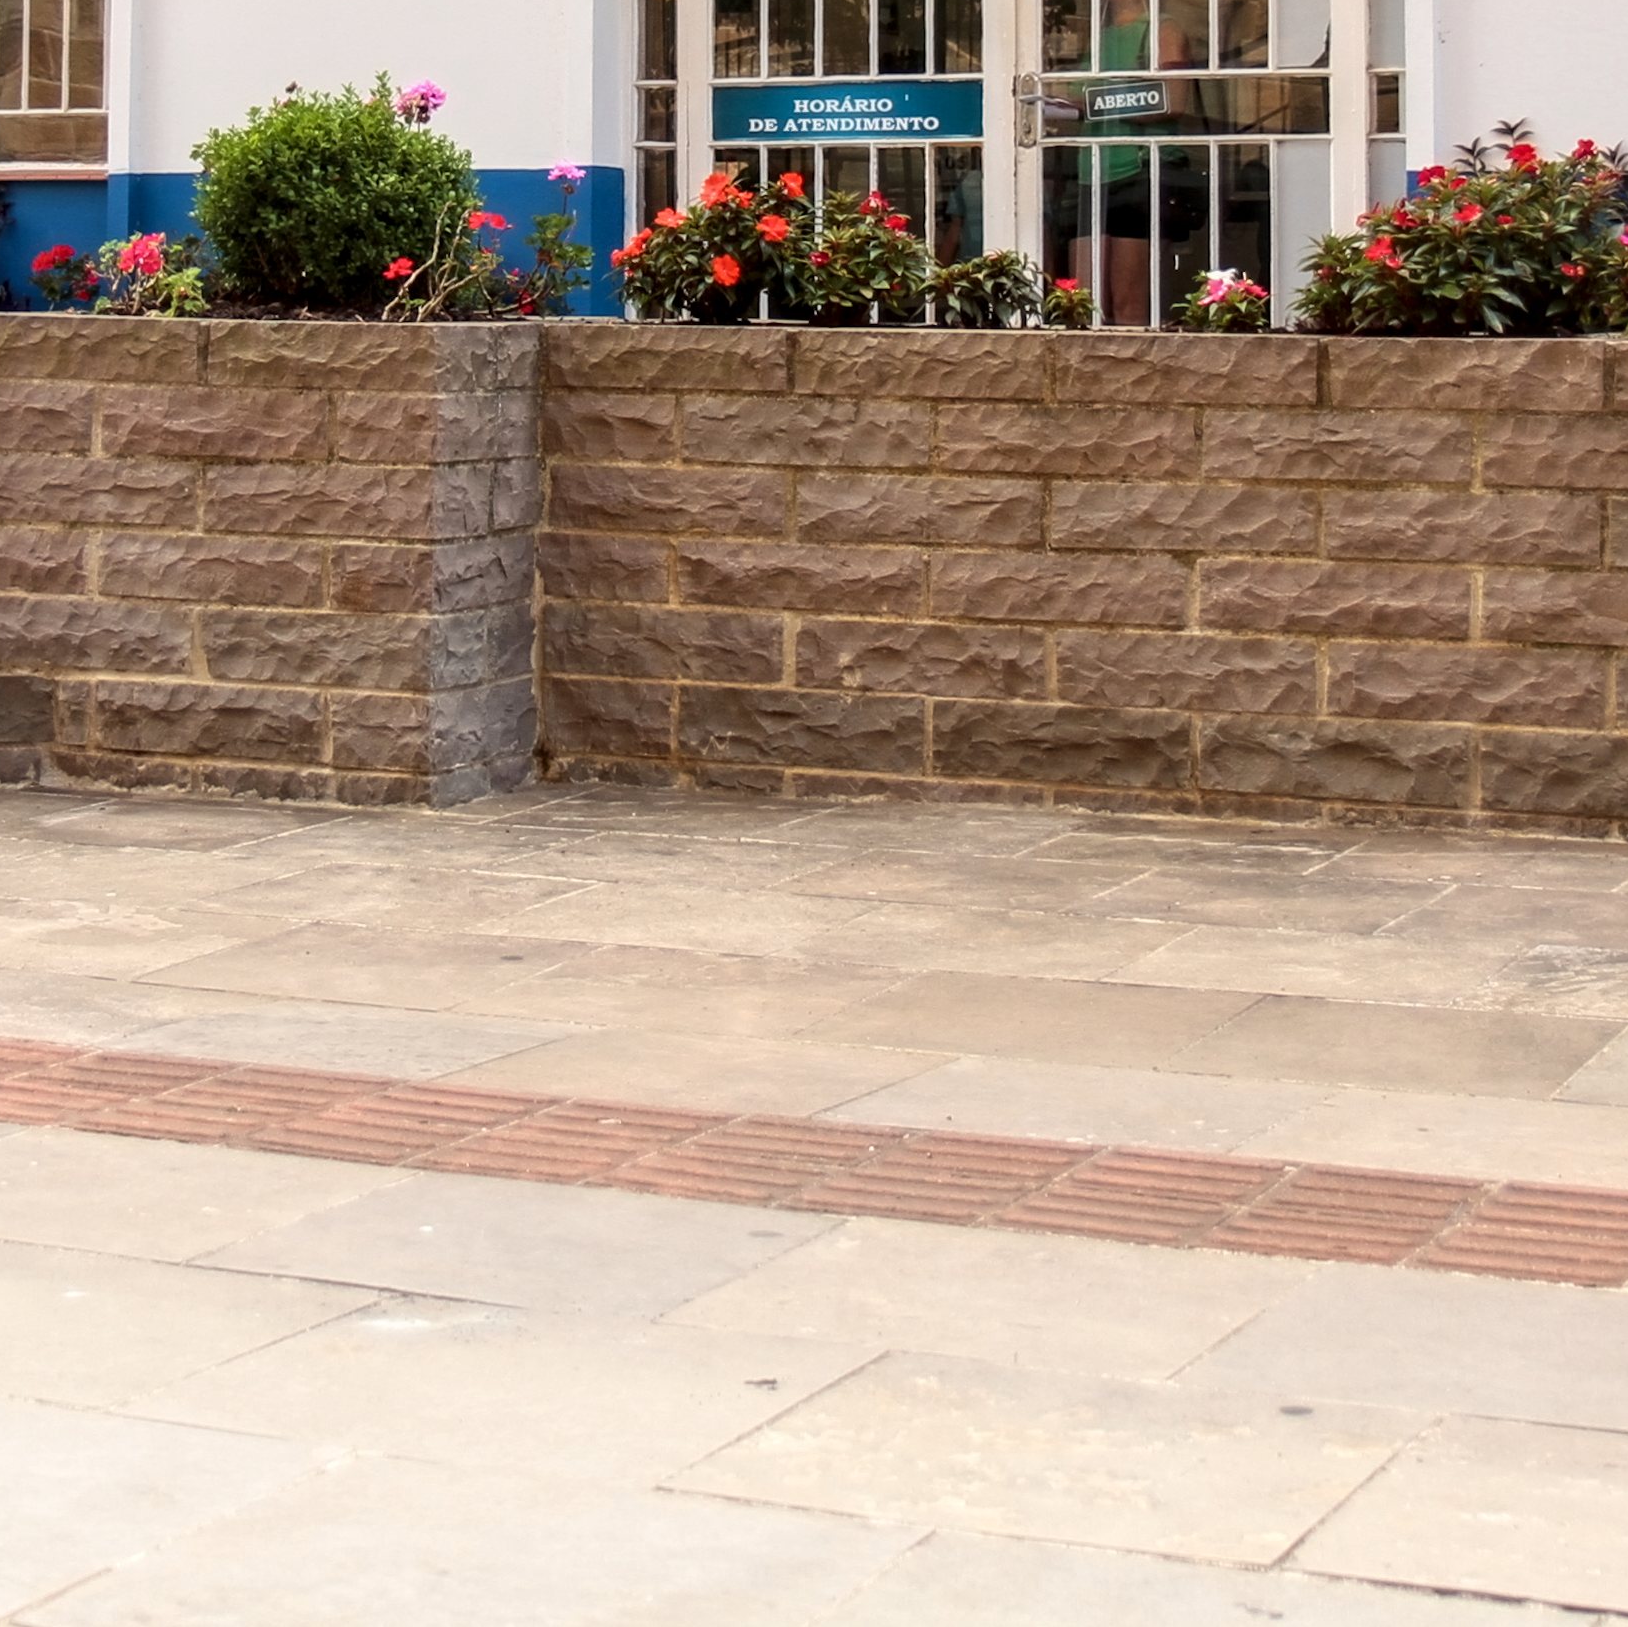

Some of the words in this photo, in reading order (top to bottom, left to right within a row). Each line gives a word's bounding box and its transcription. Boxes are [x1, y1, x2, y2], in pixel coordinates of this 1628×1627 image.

[793, 94, 893, 114] HORÁRIO
[1093, 90, 1160, 111] ABERTO
[748, 117, 778, 133] DE
[783, 115, 940, 133] ATENDIMENTO
